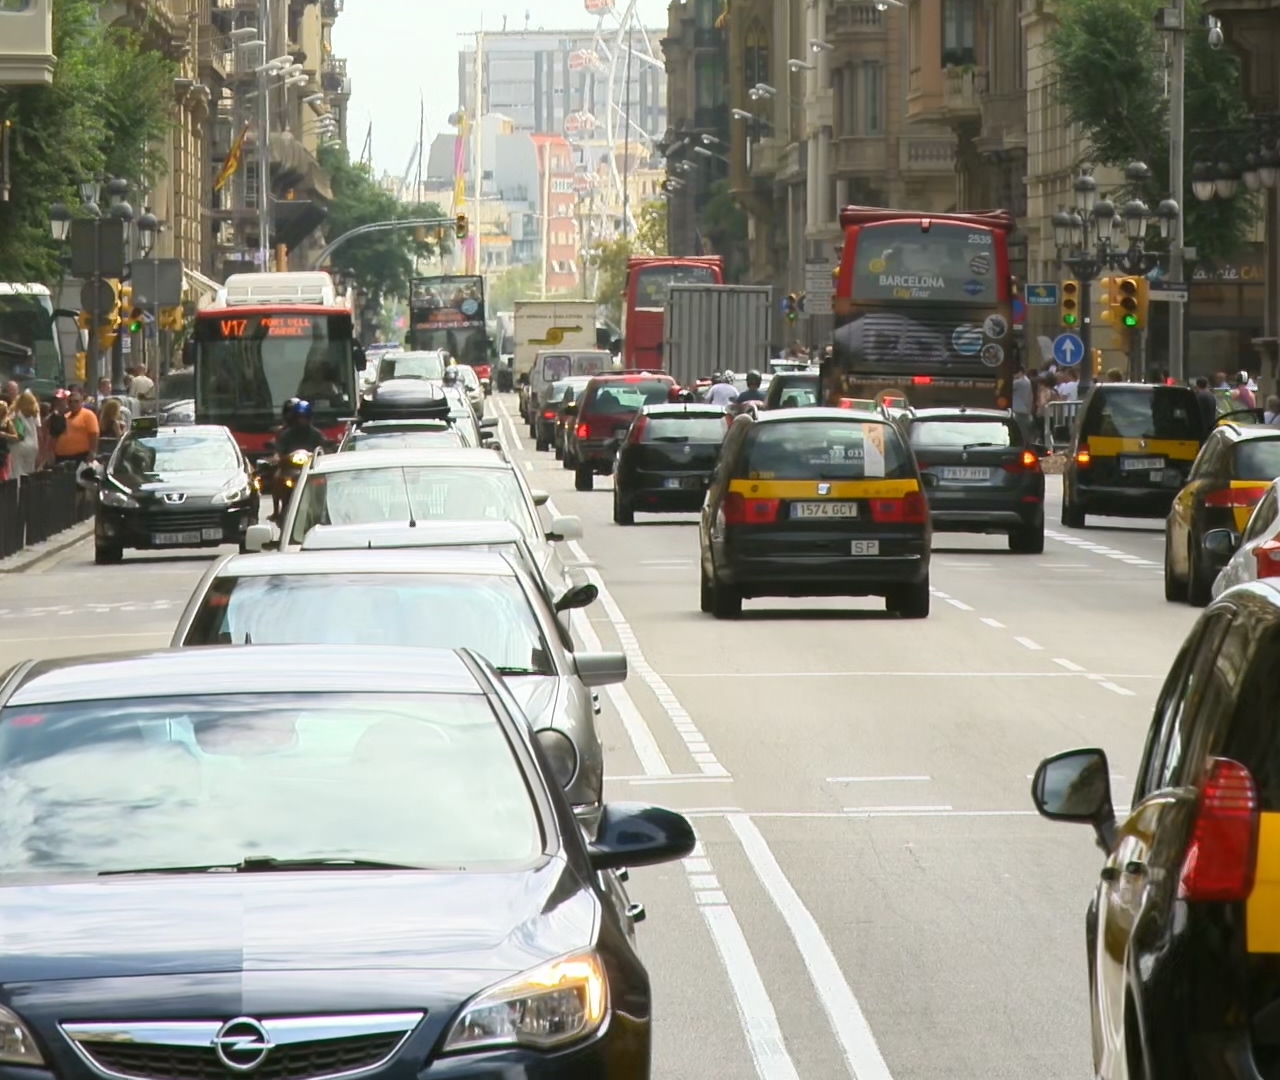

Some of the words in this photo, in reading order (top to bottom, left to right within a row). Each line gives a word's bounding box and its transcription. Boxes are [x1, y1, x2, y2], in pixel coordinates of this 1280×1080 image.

[879, 275, 945, 288] BARCELONA
[221, 319, 248, 337] V17
[801, 504, 828, 516] 1574
[832, 504, 854, 515] GCY
